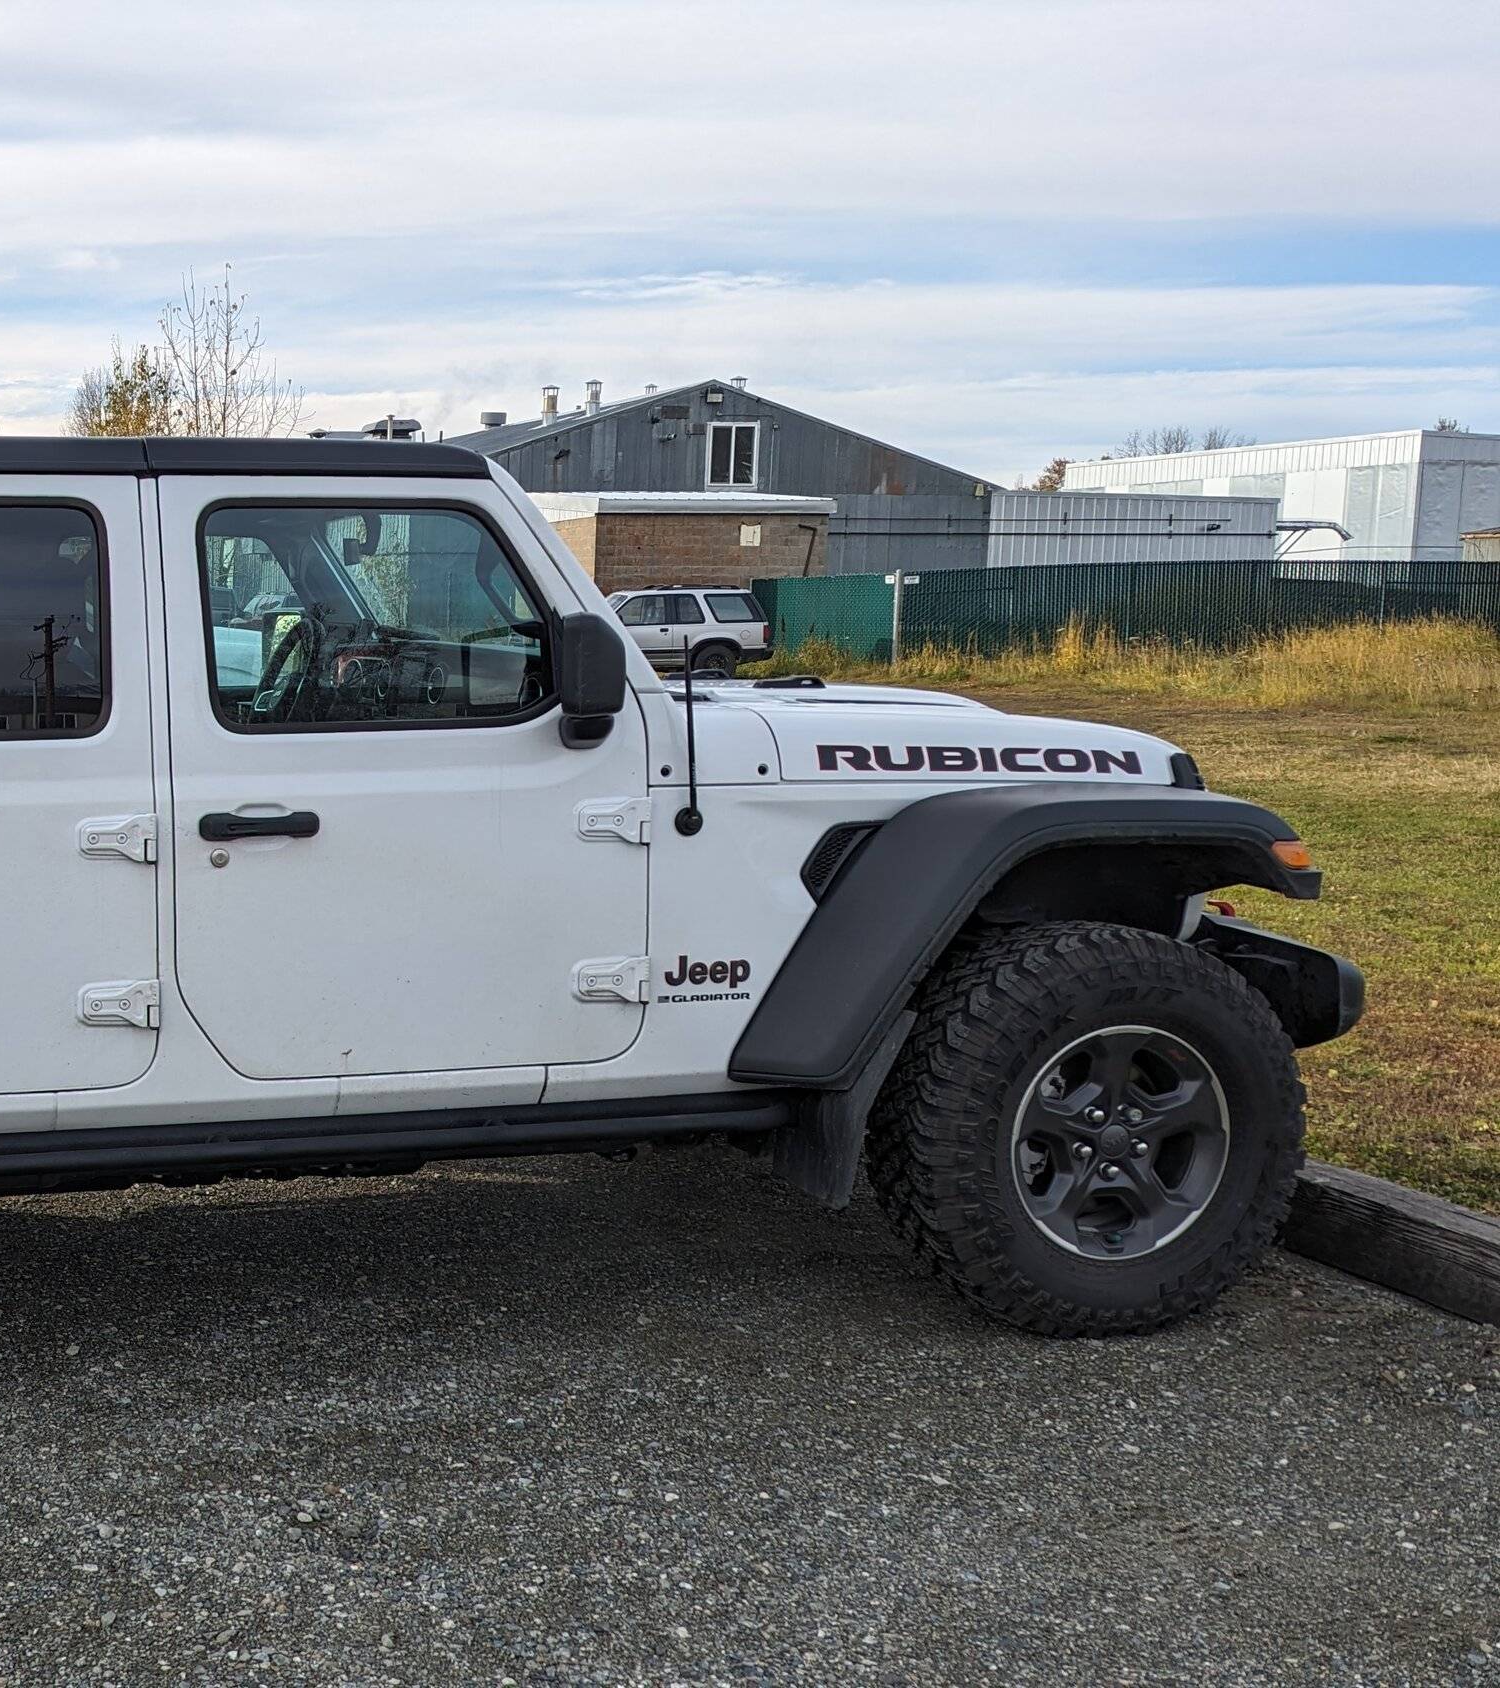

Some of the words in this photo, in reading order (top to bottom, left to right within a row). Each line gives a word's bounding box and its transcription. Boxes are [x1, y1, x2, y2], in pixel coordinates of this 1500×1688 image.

[816, 744, 1143, 774] RUBICON
[664, 954, 752, 989] Jeep
[671, 992, 751, 1003] GLADIATOR
